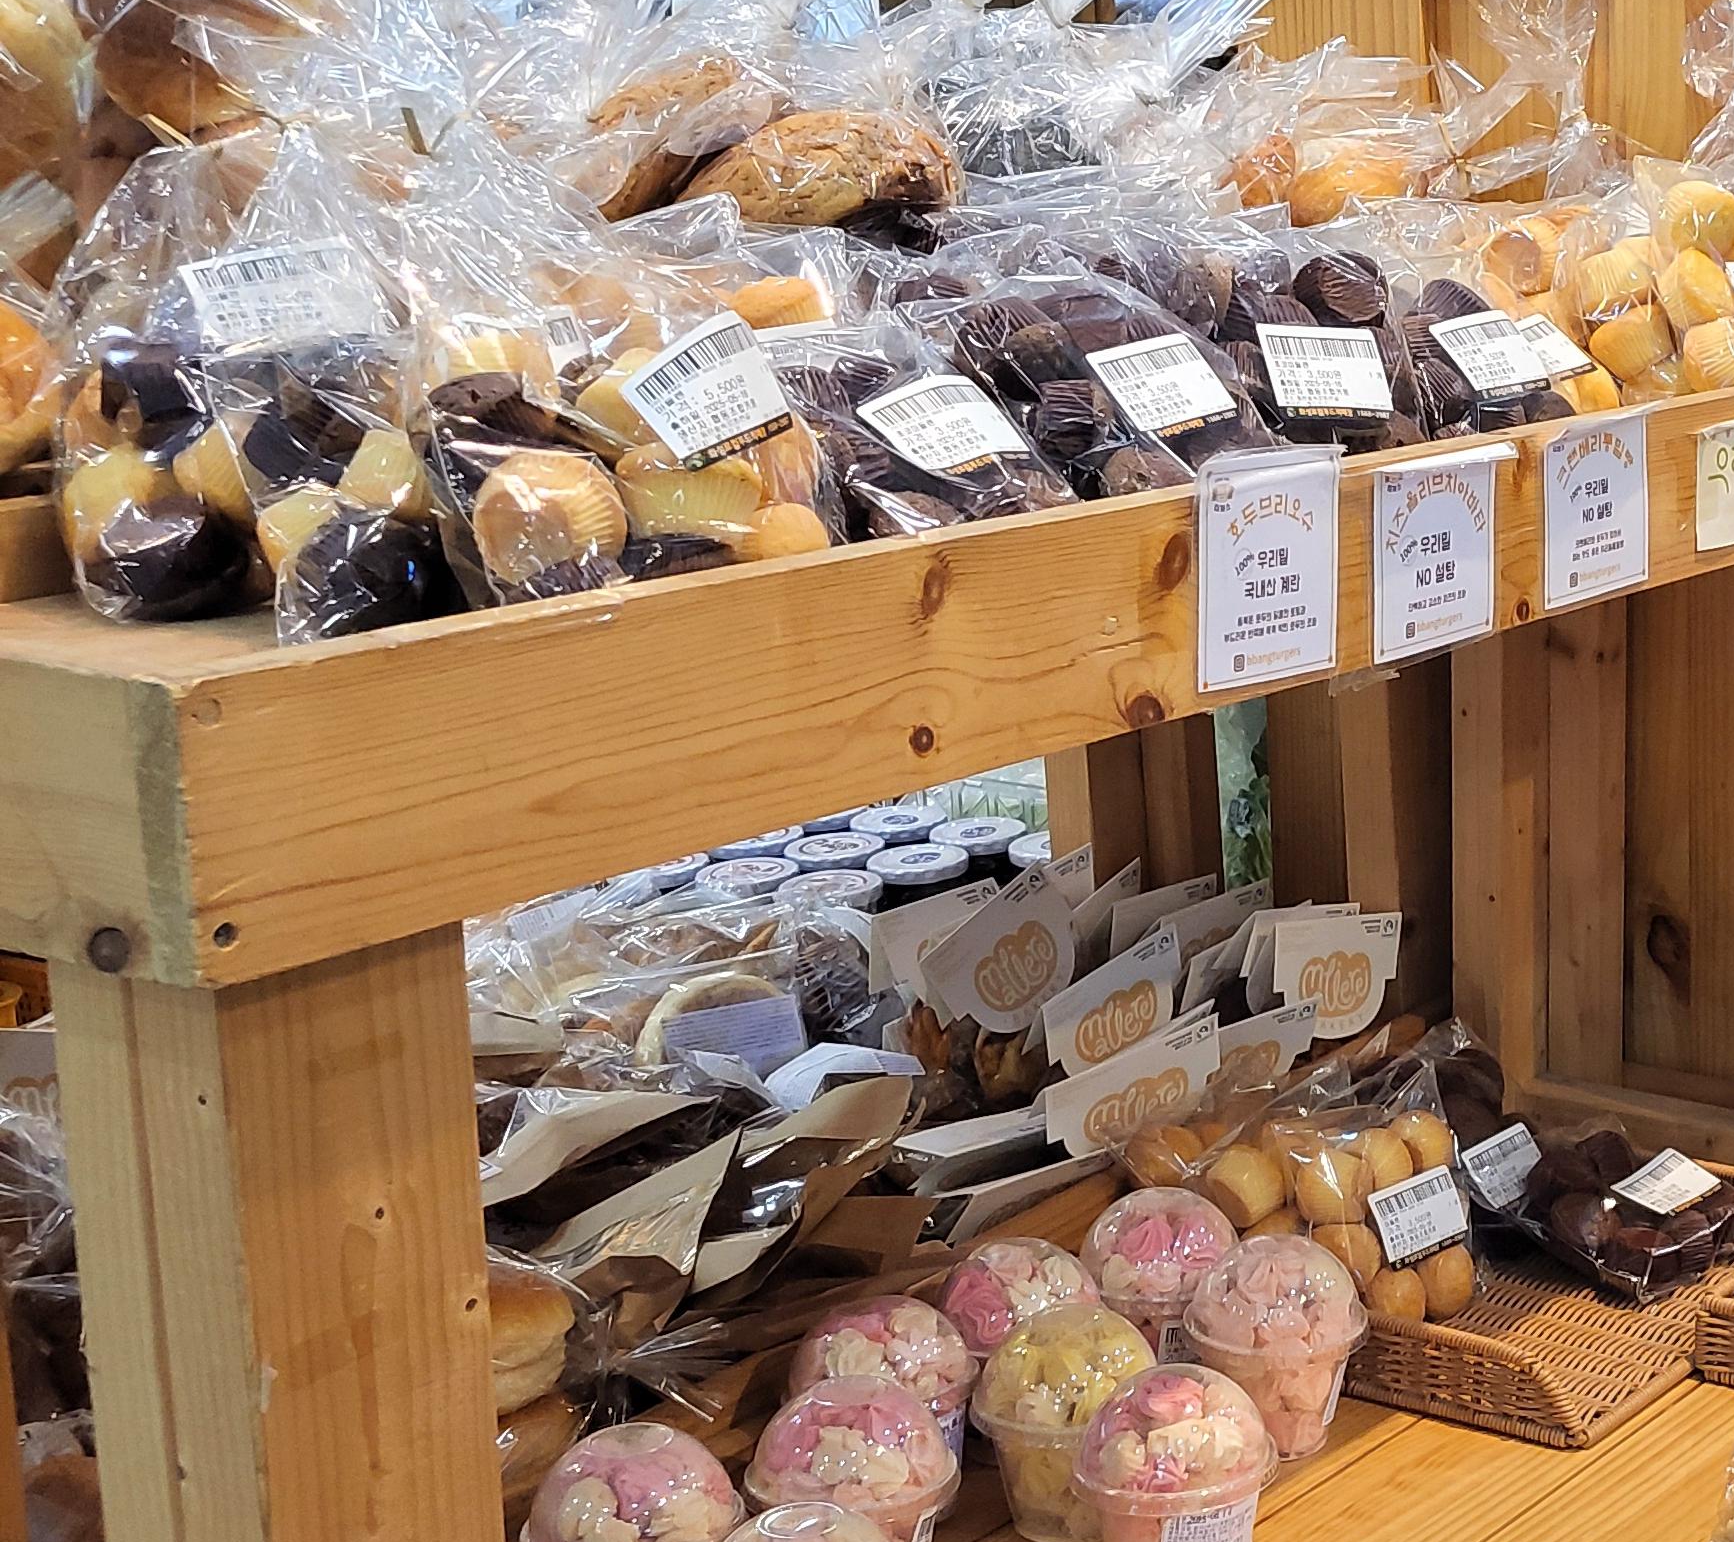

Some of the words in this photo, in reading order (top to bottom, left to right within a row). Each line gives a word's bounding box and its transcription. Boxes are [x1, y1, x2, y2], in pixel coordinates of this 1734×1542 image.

[704, 375, 746, 401] 5,500원
[1584, 478, 1609, 499] 우리밀
[1582, 507, 1594, 524] NO
[1420, 530, 1451, 557] 우리밀
[1257, 547, 1289, 570] 우리밀
[1244, 577, 1276, 600] 국내산
[1280, 574, 1301, 594] 계란
[1416, 567, 1431, 588] NO
[1435, 560, 1456, 583] 설탕
